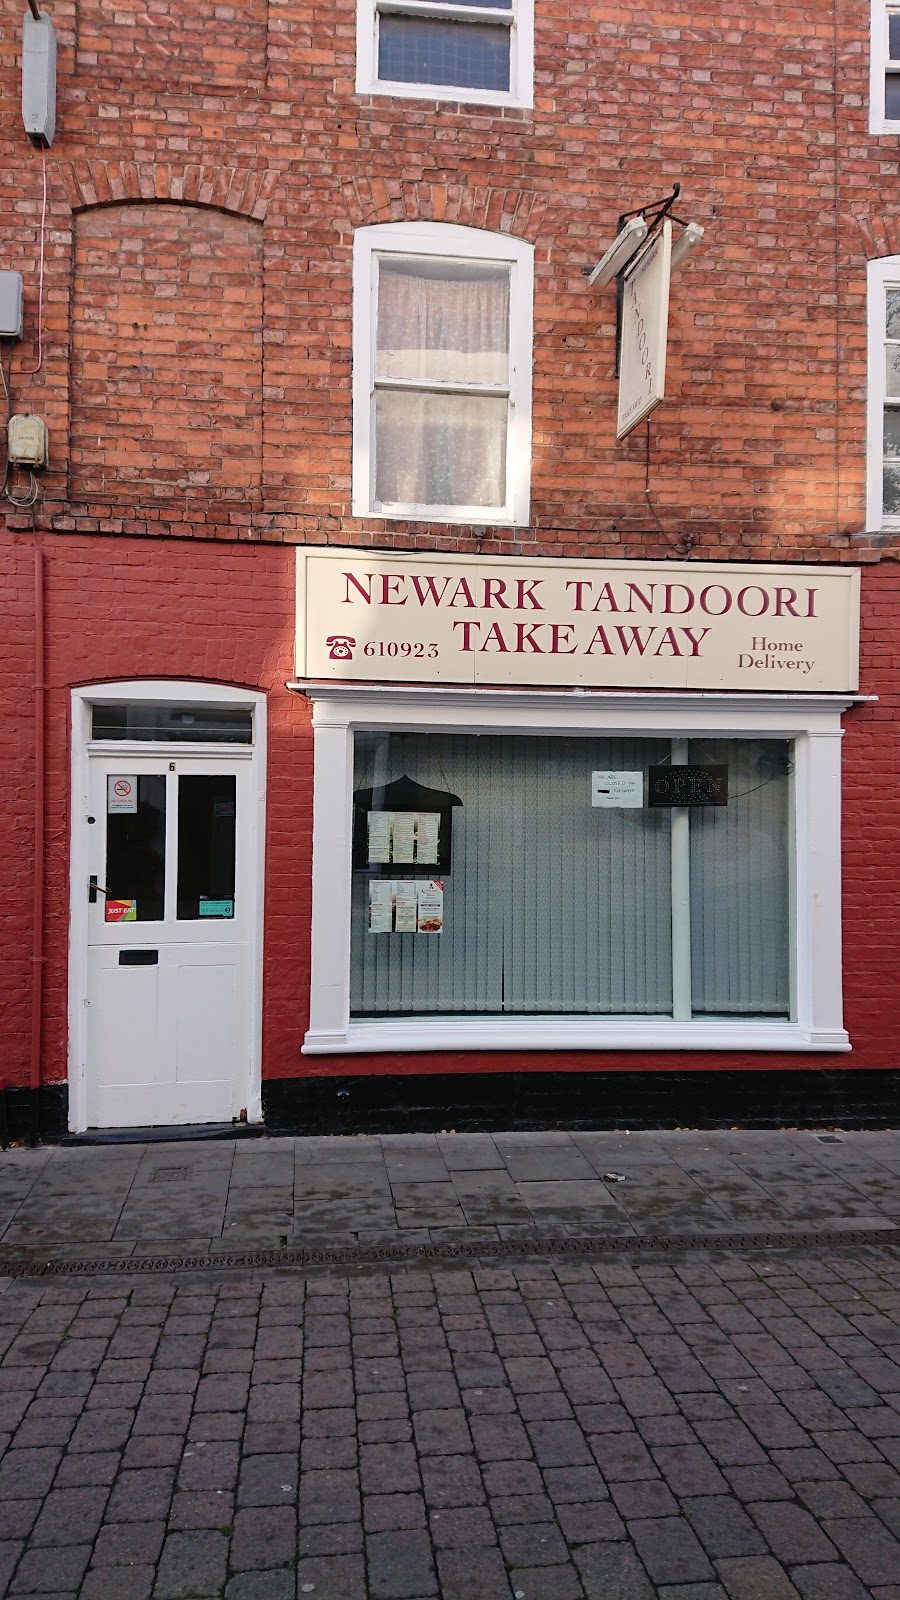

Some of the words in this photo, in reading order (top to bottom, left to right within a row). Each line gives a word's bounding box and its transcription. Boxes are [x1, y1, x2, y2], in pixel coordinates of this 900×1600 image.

[629, 278, 653, 396] TANDOORI
[340, 572, 546, 610] NEWARK
[565, 580, 819, 618] TANDOORI
[452, 621, 713, 657] TAKEAWAY
[751, 636, 804, 652] Home
[363, 641, 439, 658] 610923
[737, 653, 816, 674] Delivery
[169, 762, 175, 771] 6
[655, 777, 722, 794] OPEN
